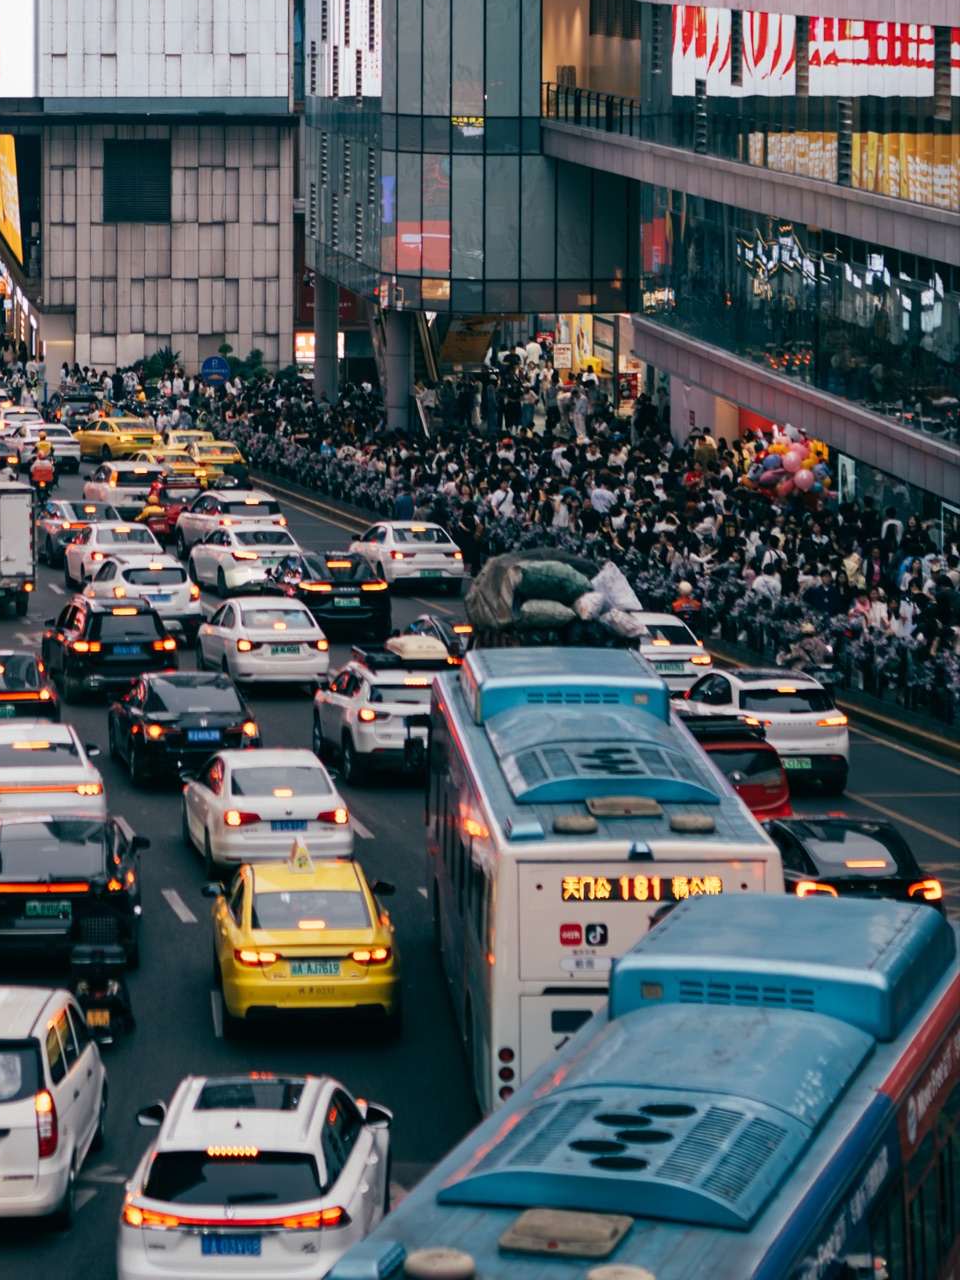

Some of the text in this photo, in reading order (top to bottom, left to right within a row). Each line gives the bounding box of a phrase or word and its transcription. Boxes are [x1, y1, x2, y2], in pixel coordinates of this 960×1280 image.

[562, 874, 723, 901] 天门公 181 杨公桥
